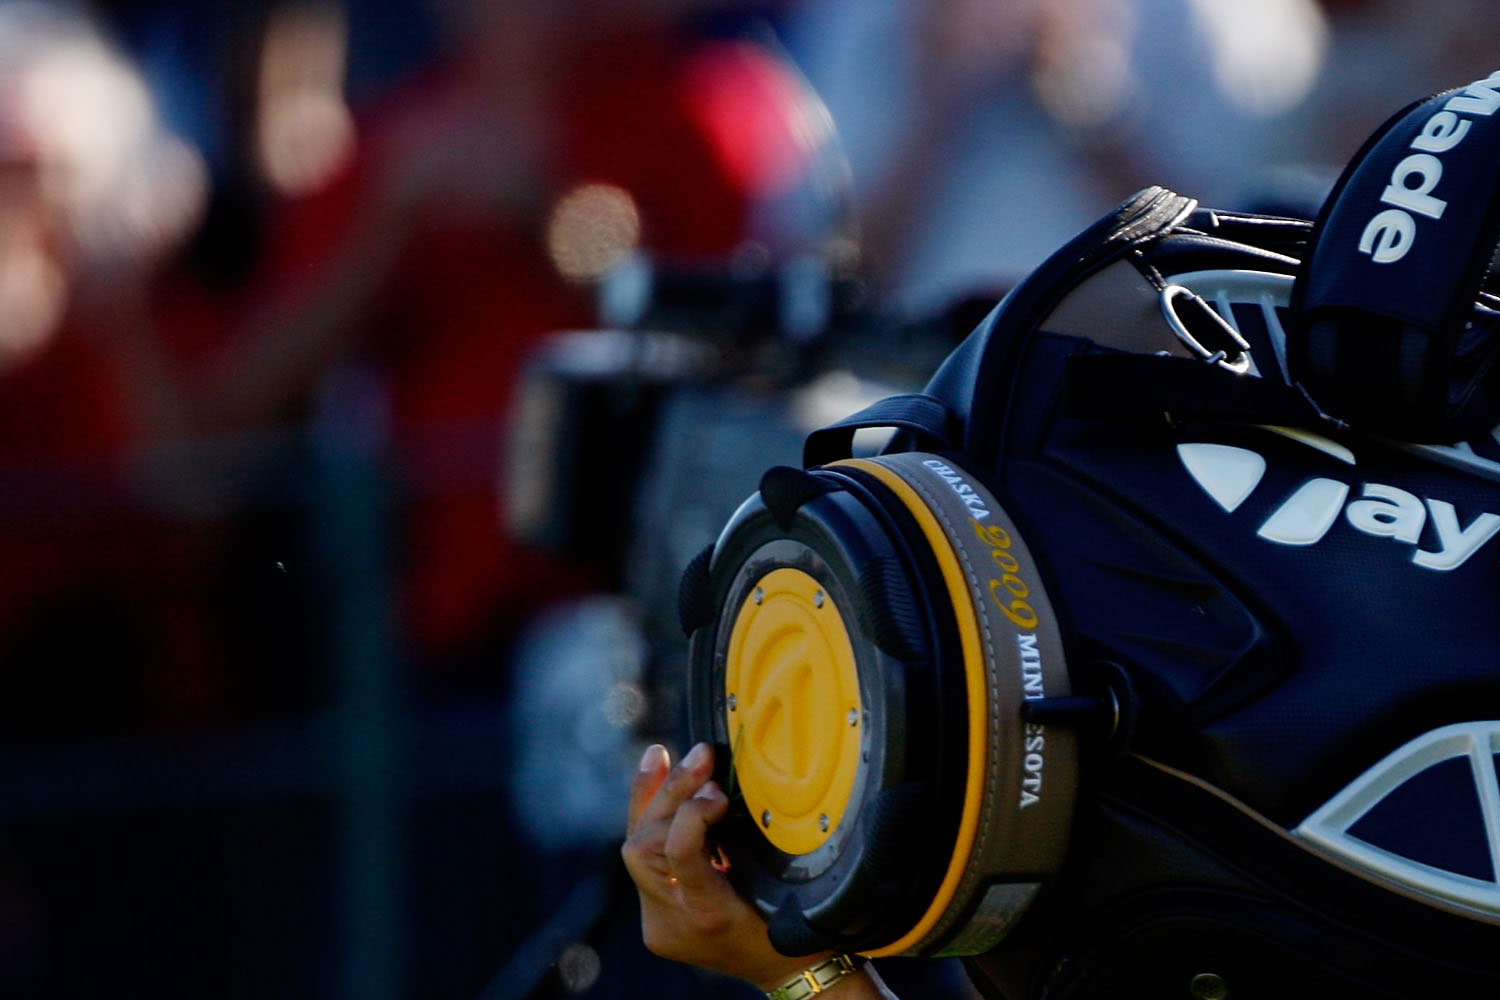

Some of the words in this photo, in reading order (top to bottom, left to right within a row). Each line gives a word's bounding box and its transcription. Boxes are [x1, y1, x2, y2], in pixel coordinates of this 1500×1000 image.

[922, 459, 990, 521] CHASKA
[968, 517, 1039, 630] 2009
[1018, 633, 1045, 810] MINESOTA
